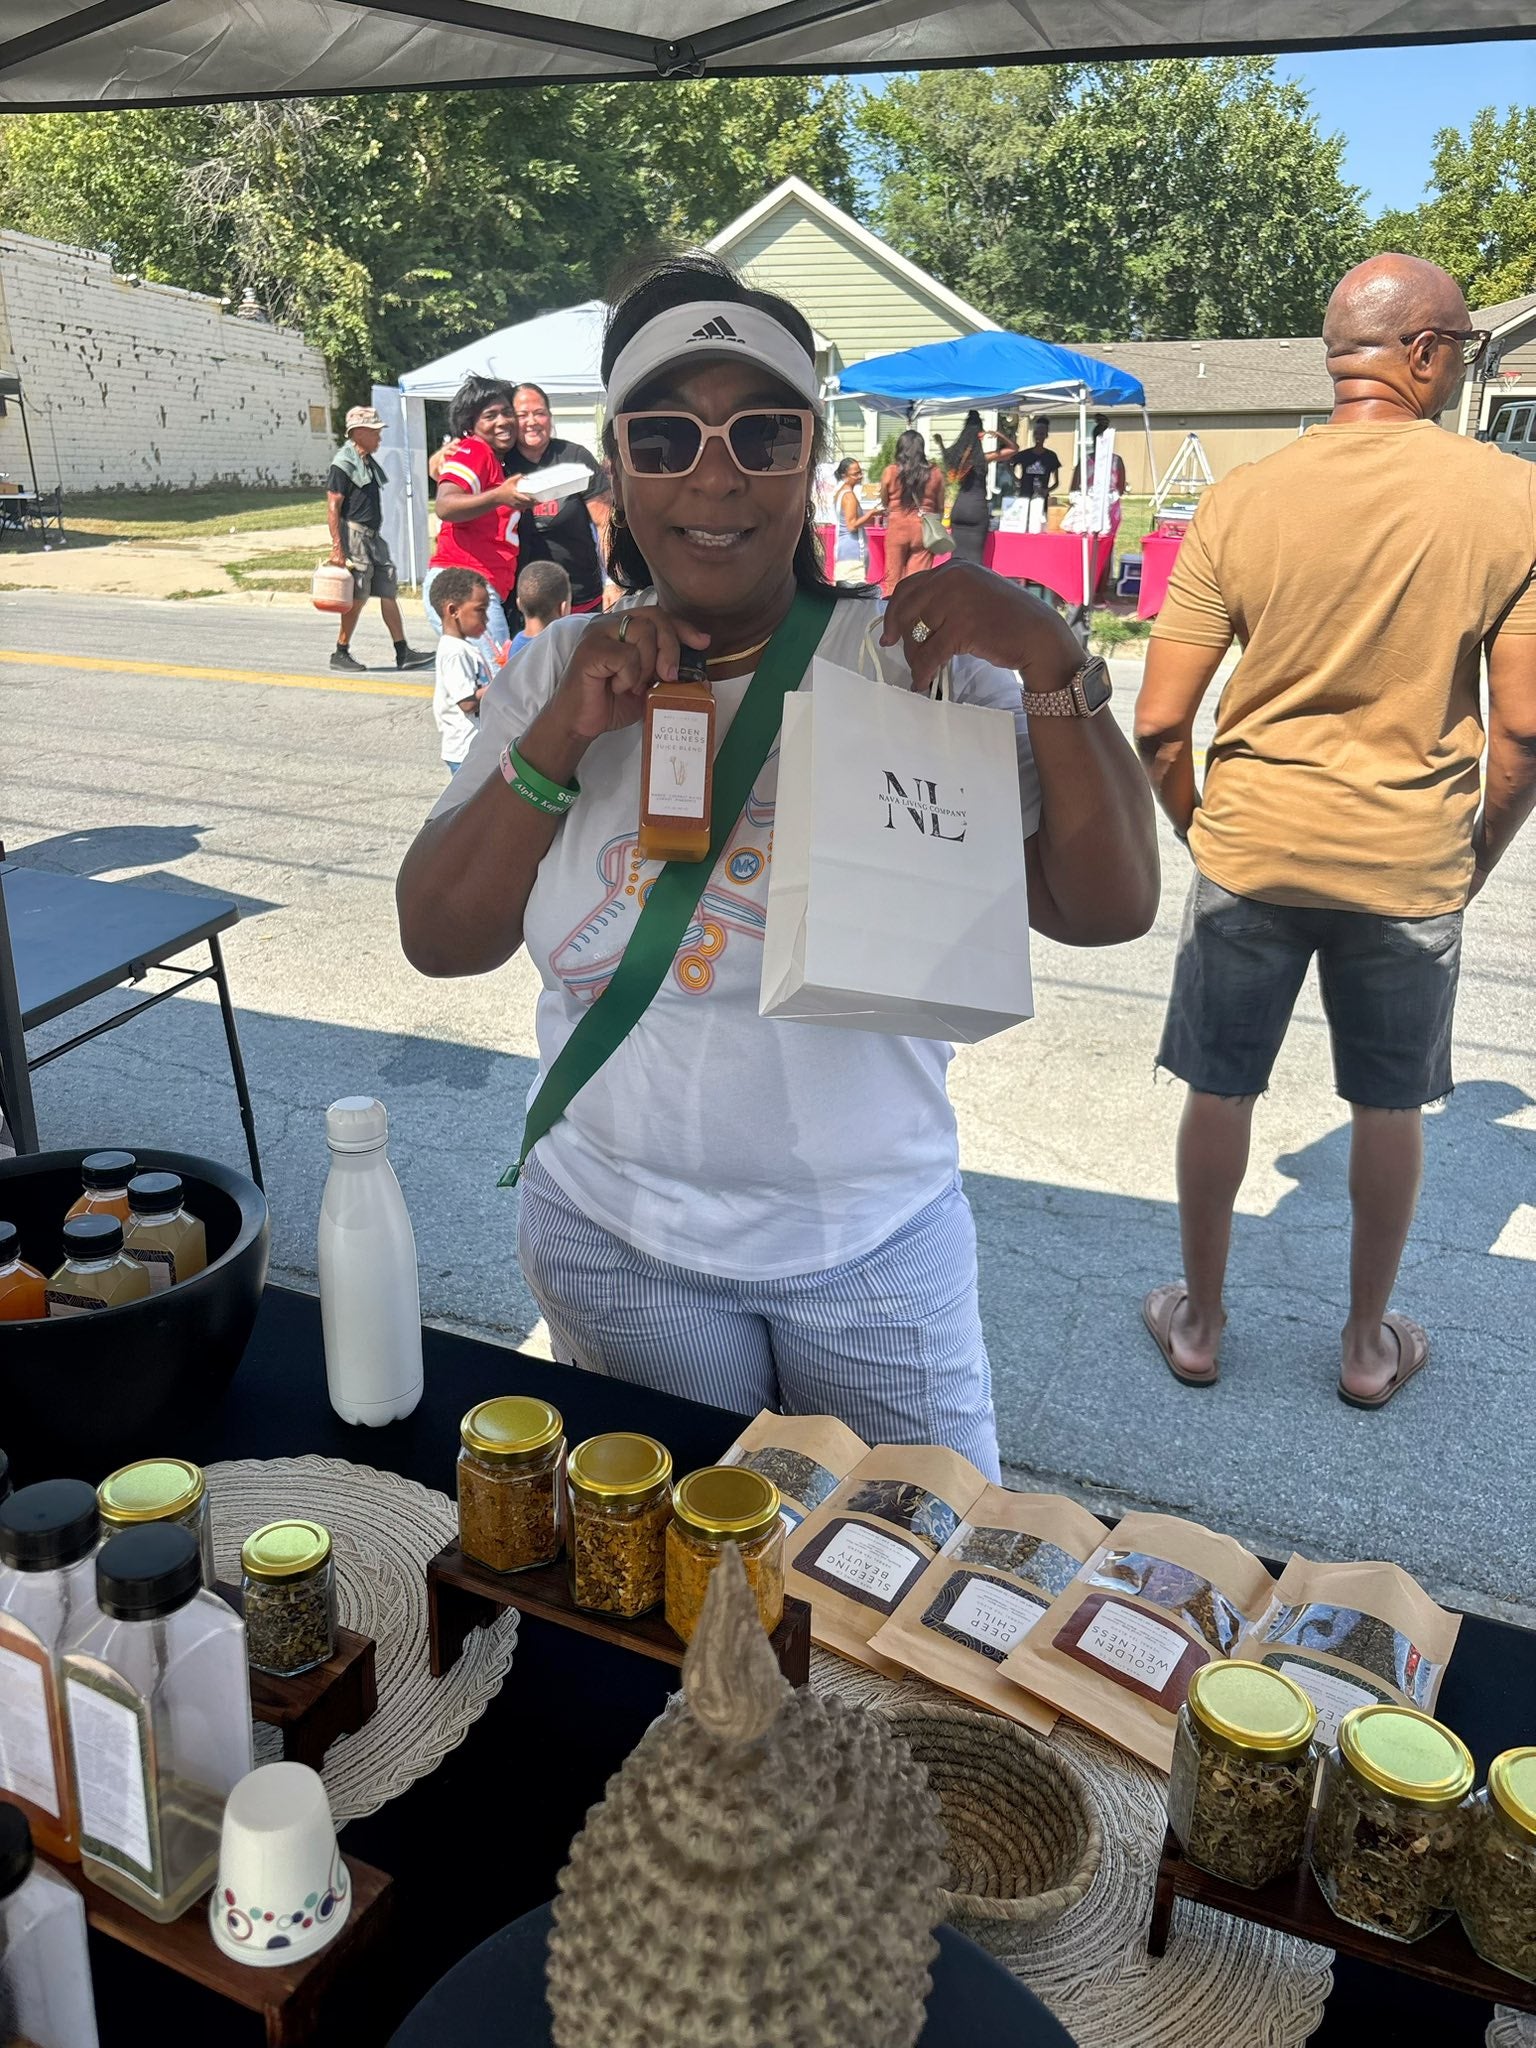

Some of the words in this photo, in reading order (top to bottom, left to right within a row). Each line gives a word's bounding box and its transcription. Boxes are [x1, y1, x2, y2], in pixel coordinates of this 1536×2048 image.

[654, 733, 706, 744] WELLNESS
[660, 726, 701, 736] GOLDEN
[515, 783, 539, 802] Alpha
[878, 793, 901, 805] NAVA
[902, 798, 928, 811] LIVING
[929, 805, 967, 818] COMPANY
[826, 1555, 891, 1592] SLEEPING
[837, 1551, 889, 1579] BEAUTY
[970, 1618, 1011, 1642] DEEP
[974, 1608, 1018, 1634] CHILL
[1091, 1625, 1168, 1671] WELLNESS
[1094, 1638, 1156, 1675] GOLDEN
